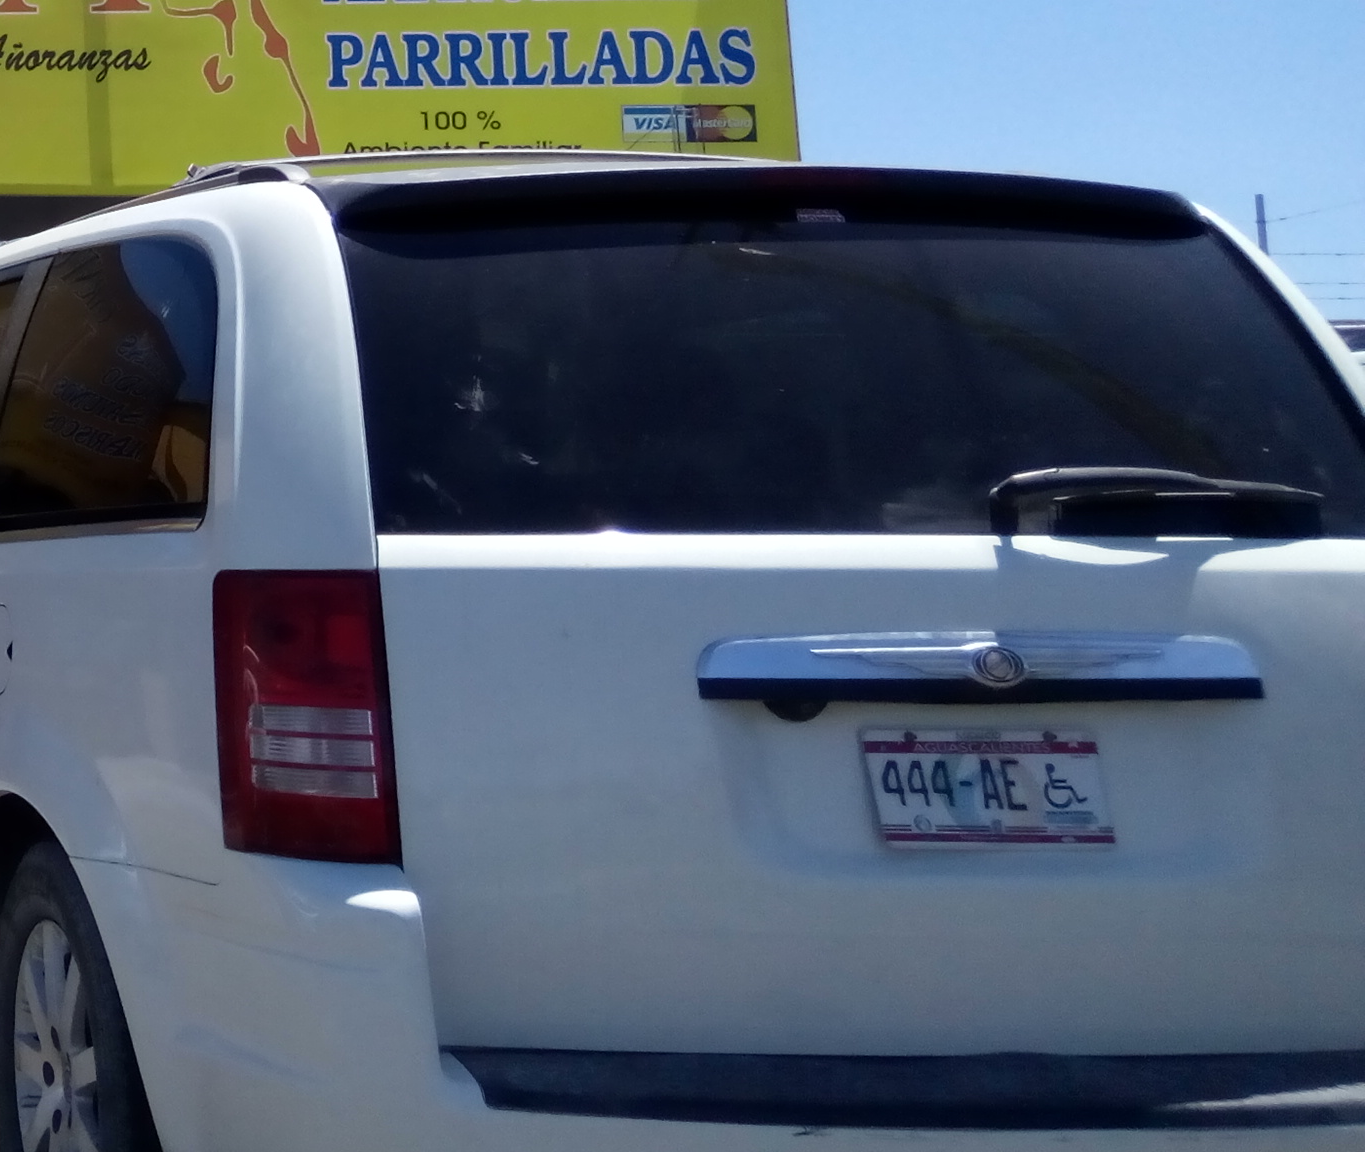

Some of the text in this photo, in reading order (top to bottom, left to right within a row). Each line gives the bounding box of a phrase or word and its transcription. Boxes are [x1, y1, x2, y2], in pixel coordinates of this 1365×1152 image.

[325, 28, 757, 91] PARRILLADAS
[419, 110, 502, 131] 100 %
[633, 117, 676, 131] VISA
[881, 758, 1029, 811] 444-AE
